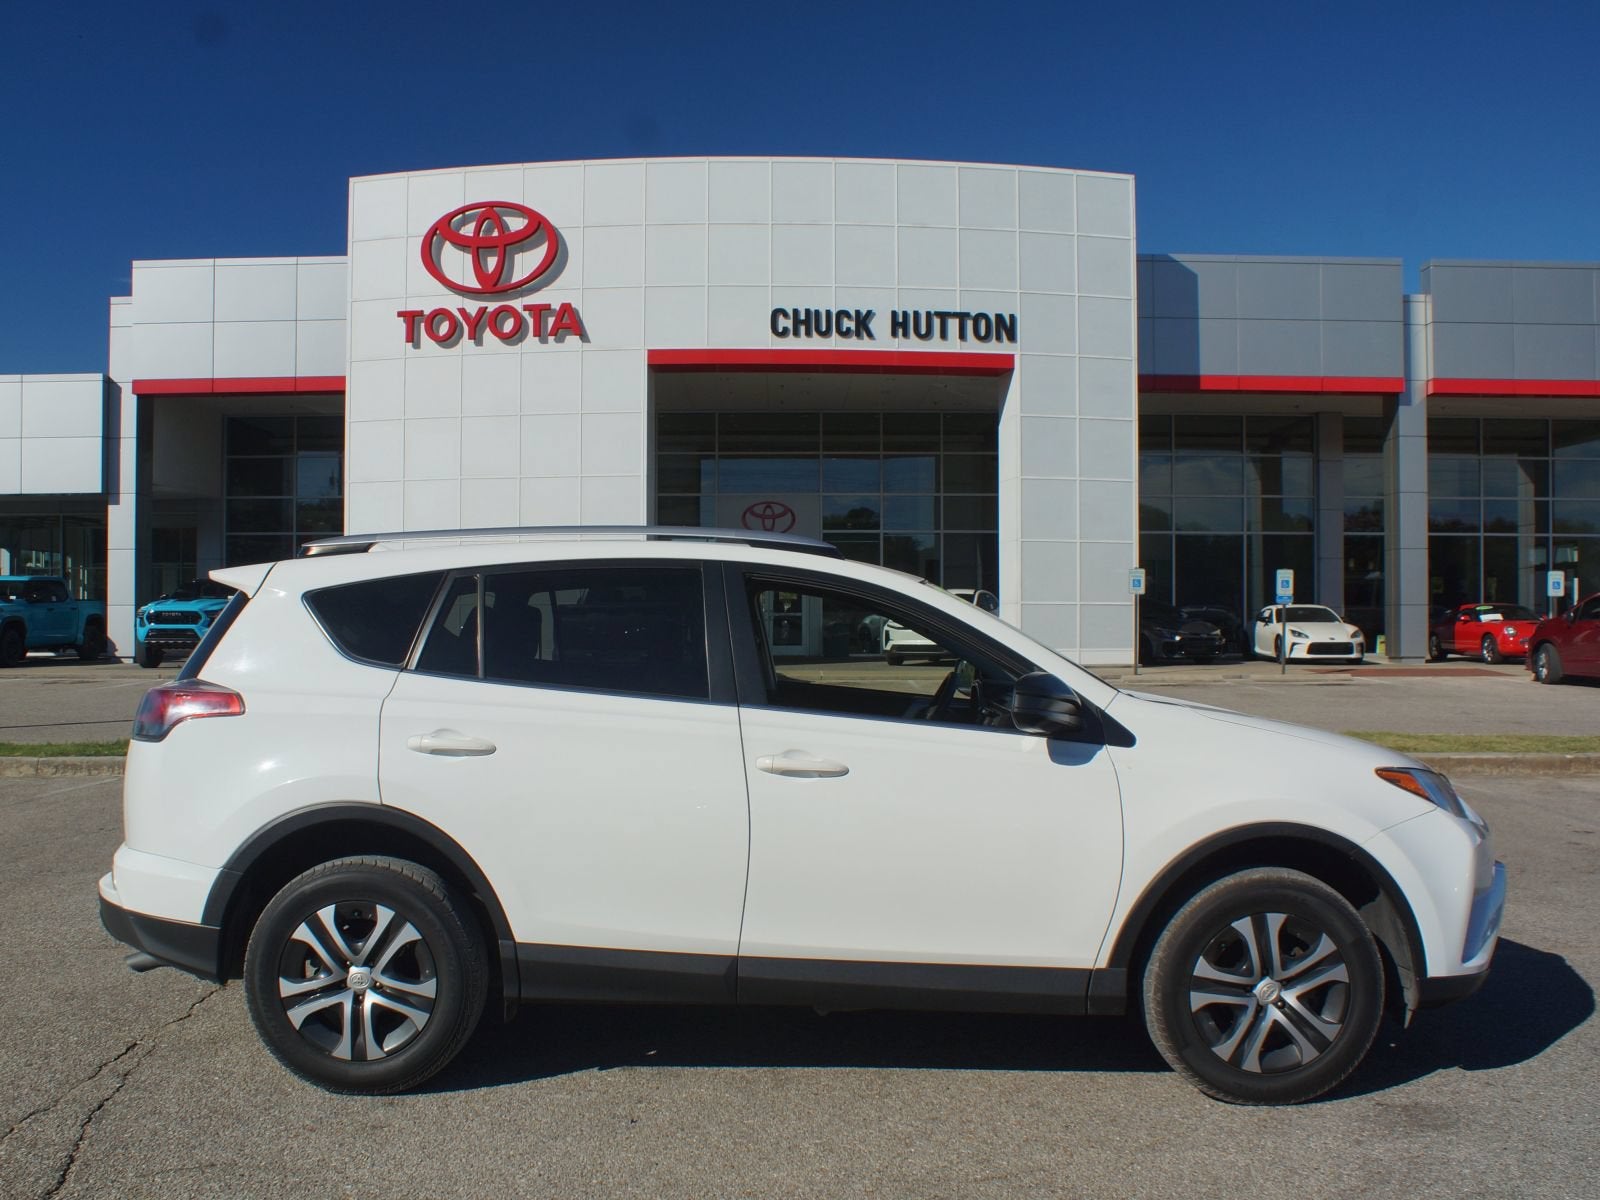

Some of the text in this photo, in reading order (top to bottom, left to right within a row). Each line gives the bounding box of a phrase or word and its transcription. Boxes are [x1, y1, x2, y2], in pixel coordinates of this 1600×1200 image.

[397, 302, 583, 343] TOYOTA
[770, 307, 1017, 342] CHUCK HUTTON
